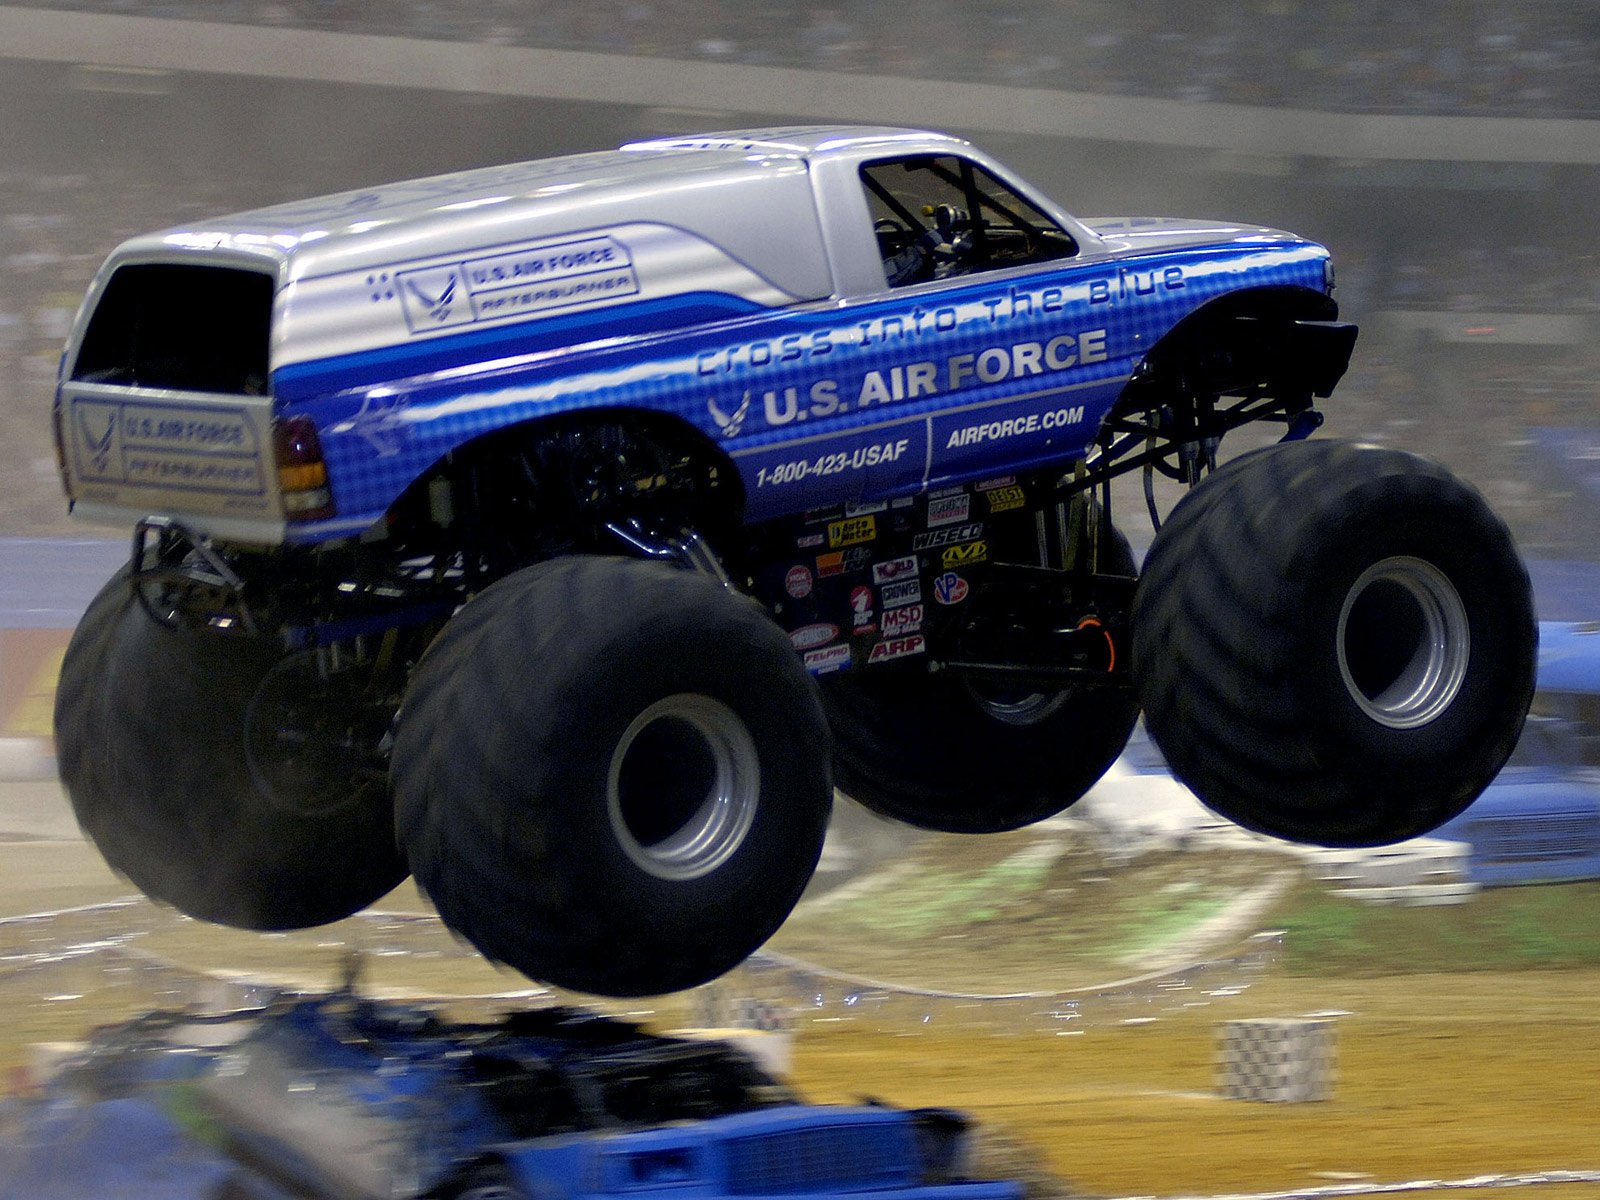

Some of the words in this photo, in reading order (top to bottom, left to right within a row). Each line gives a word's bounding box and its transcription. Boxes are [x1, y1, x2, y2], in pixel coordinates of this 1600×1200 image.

[514, 259, 544, 277] AIR
[549, 248, 616, 271] FORCE
[481, 276, 630, 311] AFTERBURNER
[763, 380, 847, 425] U.S.
[858, 363, 937, 407] AIR
[948, 329, 1108, 388] FORCE
[946, 406, 1085, 449] AIRFORCE.COM
[755, 439, 910, 488] 1-800-423-USAF
[884, 606, 921, 627] MSD
[871, 637, 924, 658] ARP
